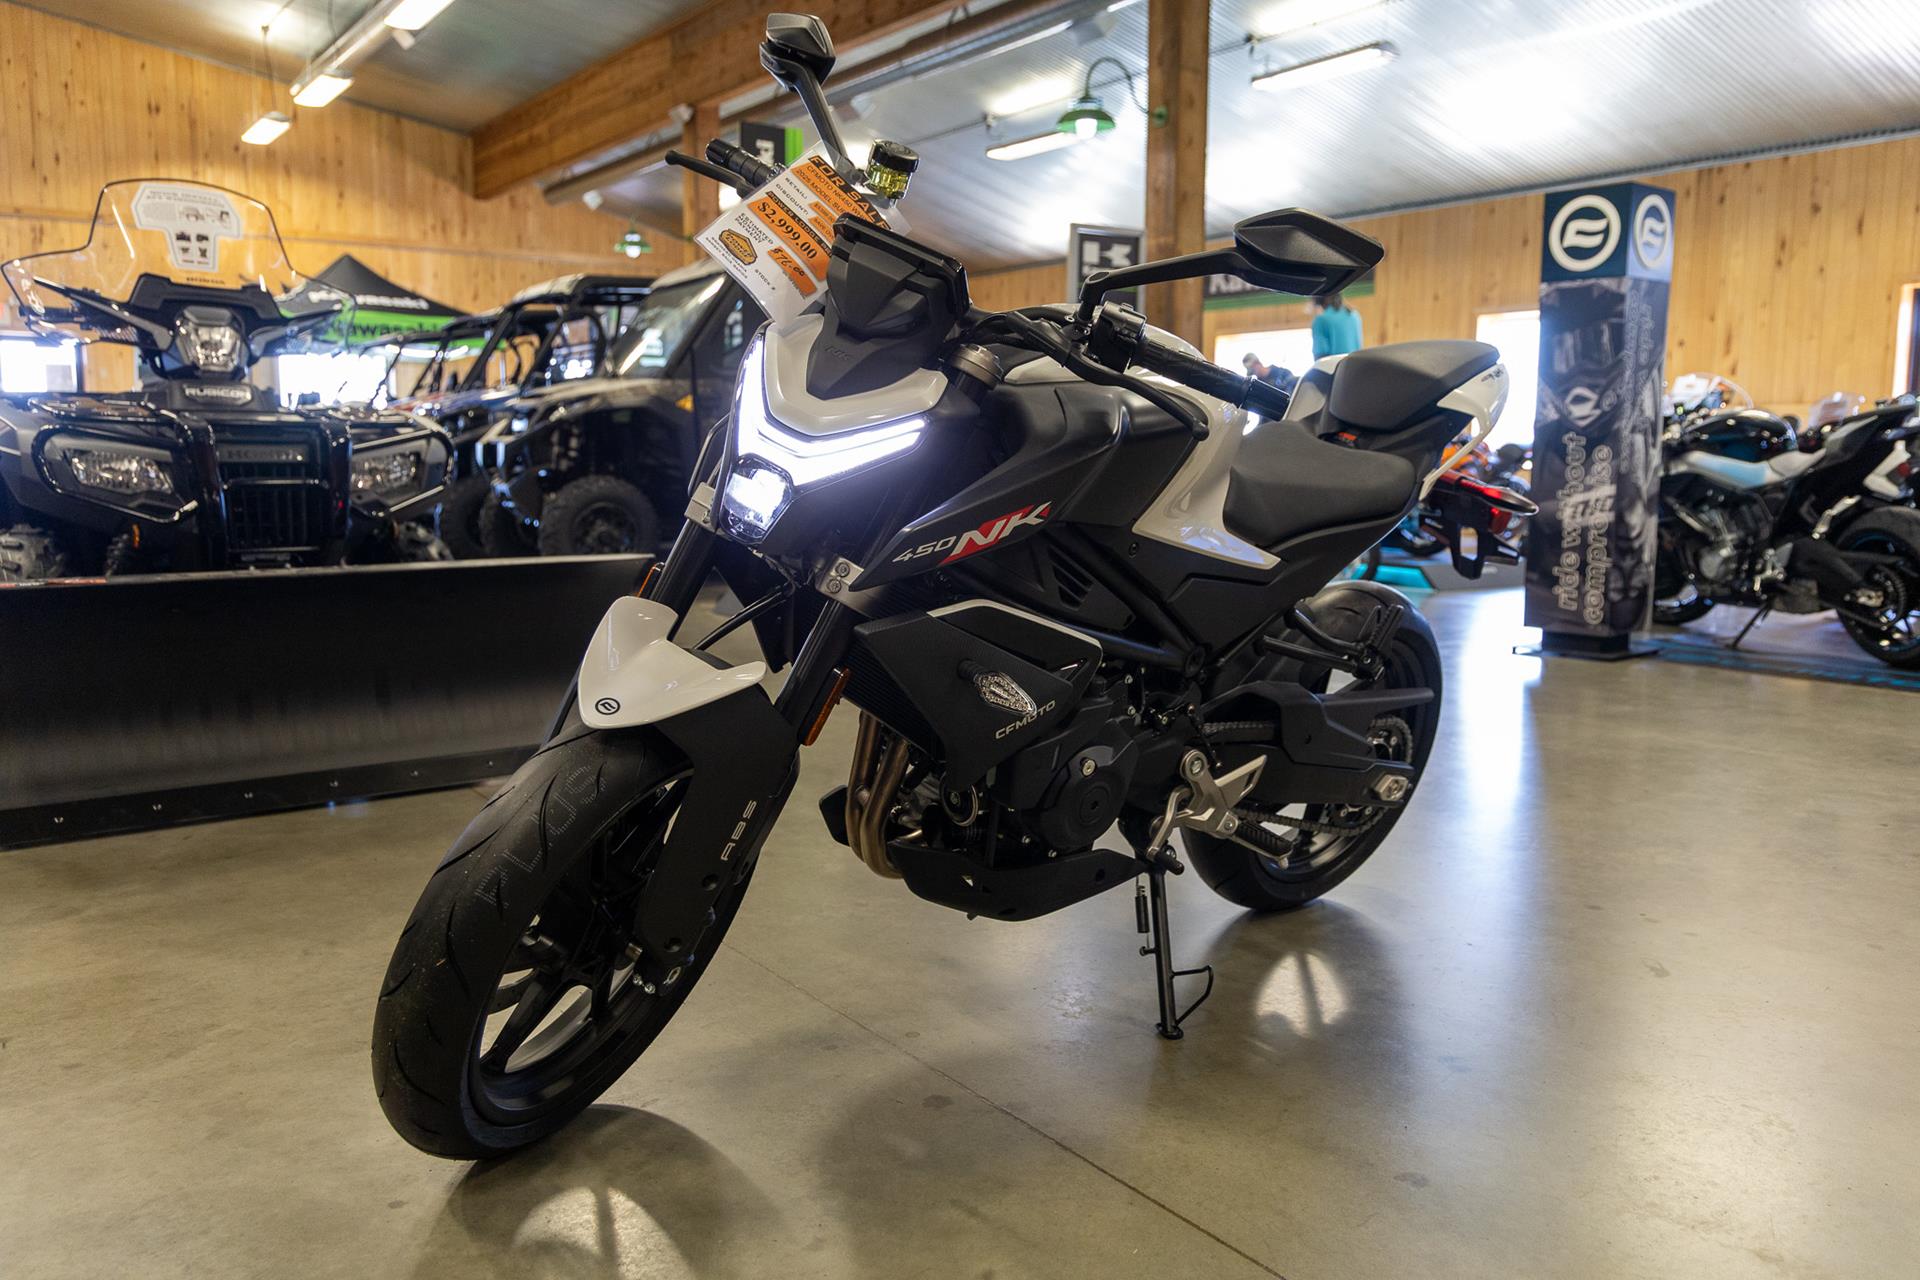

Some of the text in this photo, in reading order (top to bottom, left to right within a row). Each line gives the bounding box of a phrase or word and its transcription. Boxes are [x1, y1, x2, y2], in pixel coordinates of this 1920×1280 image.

[805, 164, 834, 191] CFMOTO
[808, 181, 833, 203] MODEL
[809, 155, 846, 187] FOR
[846, 190, 891, 232] SALE
[732, 216, 763, 244] PAYMENT
[735, 214, 766, 242] MONTHLY
[738, 211, 775, 245] ESTIMATED
[755, 200, 820, 260] $2,999.00
[766, 191, 795, 217] POWER
[792, 216, 821, 242] LODGE
[185, 386, 251, 401] RUBICON
[892, 501, 1053, 563] 450 NK
[1552, 551, 1581, 611] ride
[720, 799, 757, 861] ABS
